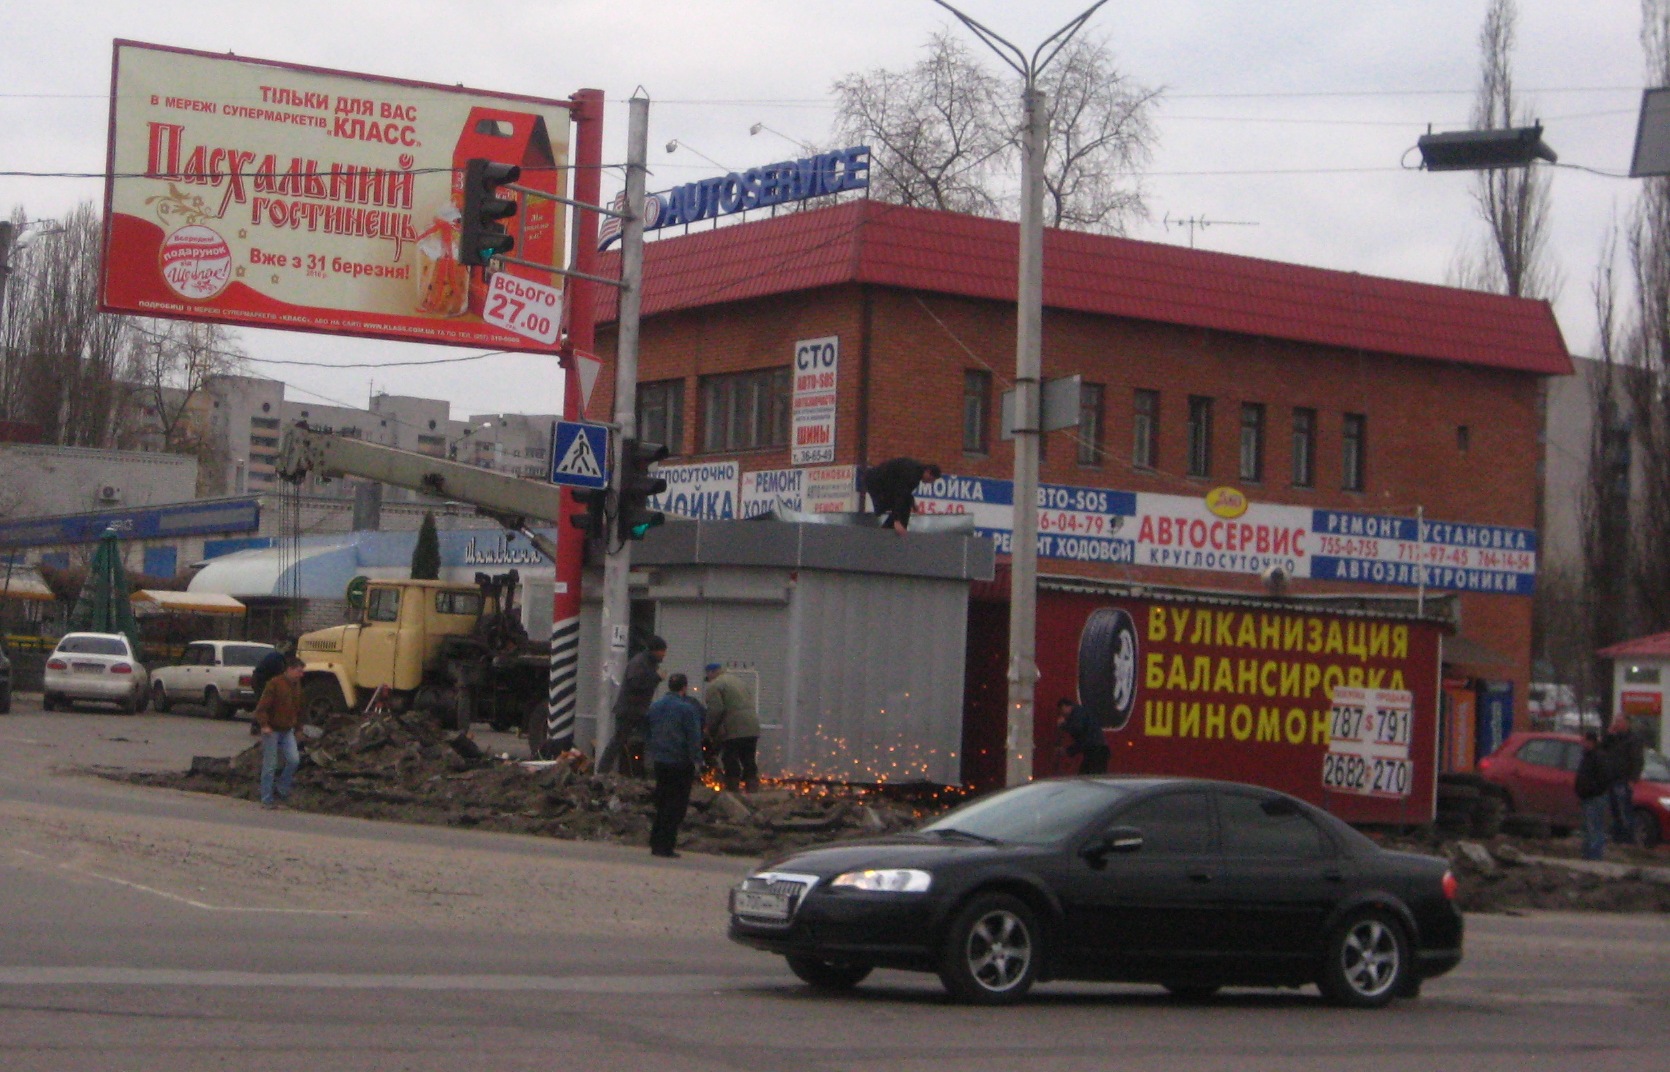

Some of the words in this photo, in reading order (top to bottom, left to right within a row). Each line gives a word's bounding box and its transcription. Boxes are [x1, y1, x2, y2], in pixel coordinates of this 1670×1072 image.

[259, 85, 329, 111] ТІЛЬКИ
[334, 96, 374, 116] ДЛЯ
[380, 102, 417, 122] ВАС
[150, 95, 159, 106] В
[165, 96, 217, 114] МЕРЕЖІ
[223, 104, 327, 128] СУПЕРМАРКЕТІВ
[326, 116, 422, 147] «КЛАСС»
[664, 146, 871, 226] AUTOSERVICE
[163, 246, 226, 262] подарунок
[250, 248, 287, 267] Вже
[292, 256, 302, 268] з
[307, 254, 326, 271] 31
[332, 257, 410, 280] березня!
[495, 276, 556, 307] ВСЬОГО
[488, 293, 551, 336] 27.00
[797, 343, 835, 370] СТО
[796, 425, 830, 445] ШИНЫ
[756, 470, 803, 493] РЕМОНТ
[912, 475, 984, 501] МОЙКА
[1036, 487, 1108, 513] ВТО-SOS
[1037, 511, 1104, 535] 6-04-79
[1138, 514, 1305, 557] АВТОСЕРВИС
[1328, 514, 1401, 538] РЕМОНТ
[1421, 523, 1526, 549] УСТАНОВКА
[993, 532, 1051, 556] РЕНТ
[1057, 537, 1132, 562] ХОДОВОЙ
[1320, 536, 1378, 557] 755-0-755
[1336, 560, 1517, 591] АВТОЭЛЕКТРОНИКИ
[1147, 606, 1409, 662] ВУЛКАНИЗАЦИЯ
[1145, 653, 1406, 700] БАЛАНСИРОВКА
[1144, 700, 1331, 745] ШИНОМОН
[1332, 707, 1363, 738] 787
[1377, 710, 1408, 742] 791
[1324, 755, 1365, 788] 2682
[1373, 759, 1407, 792] 270
